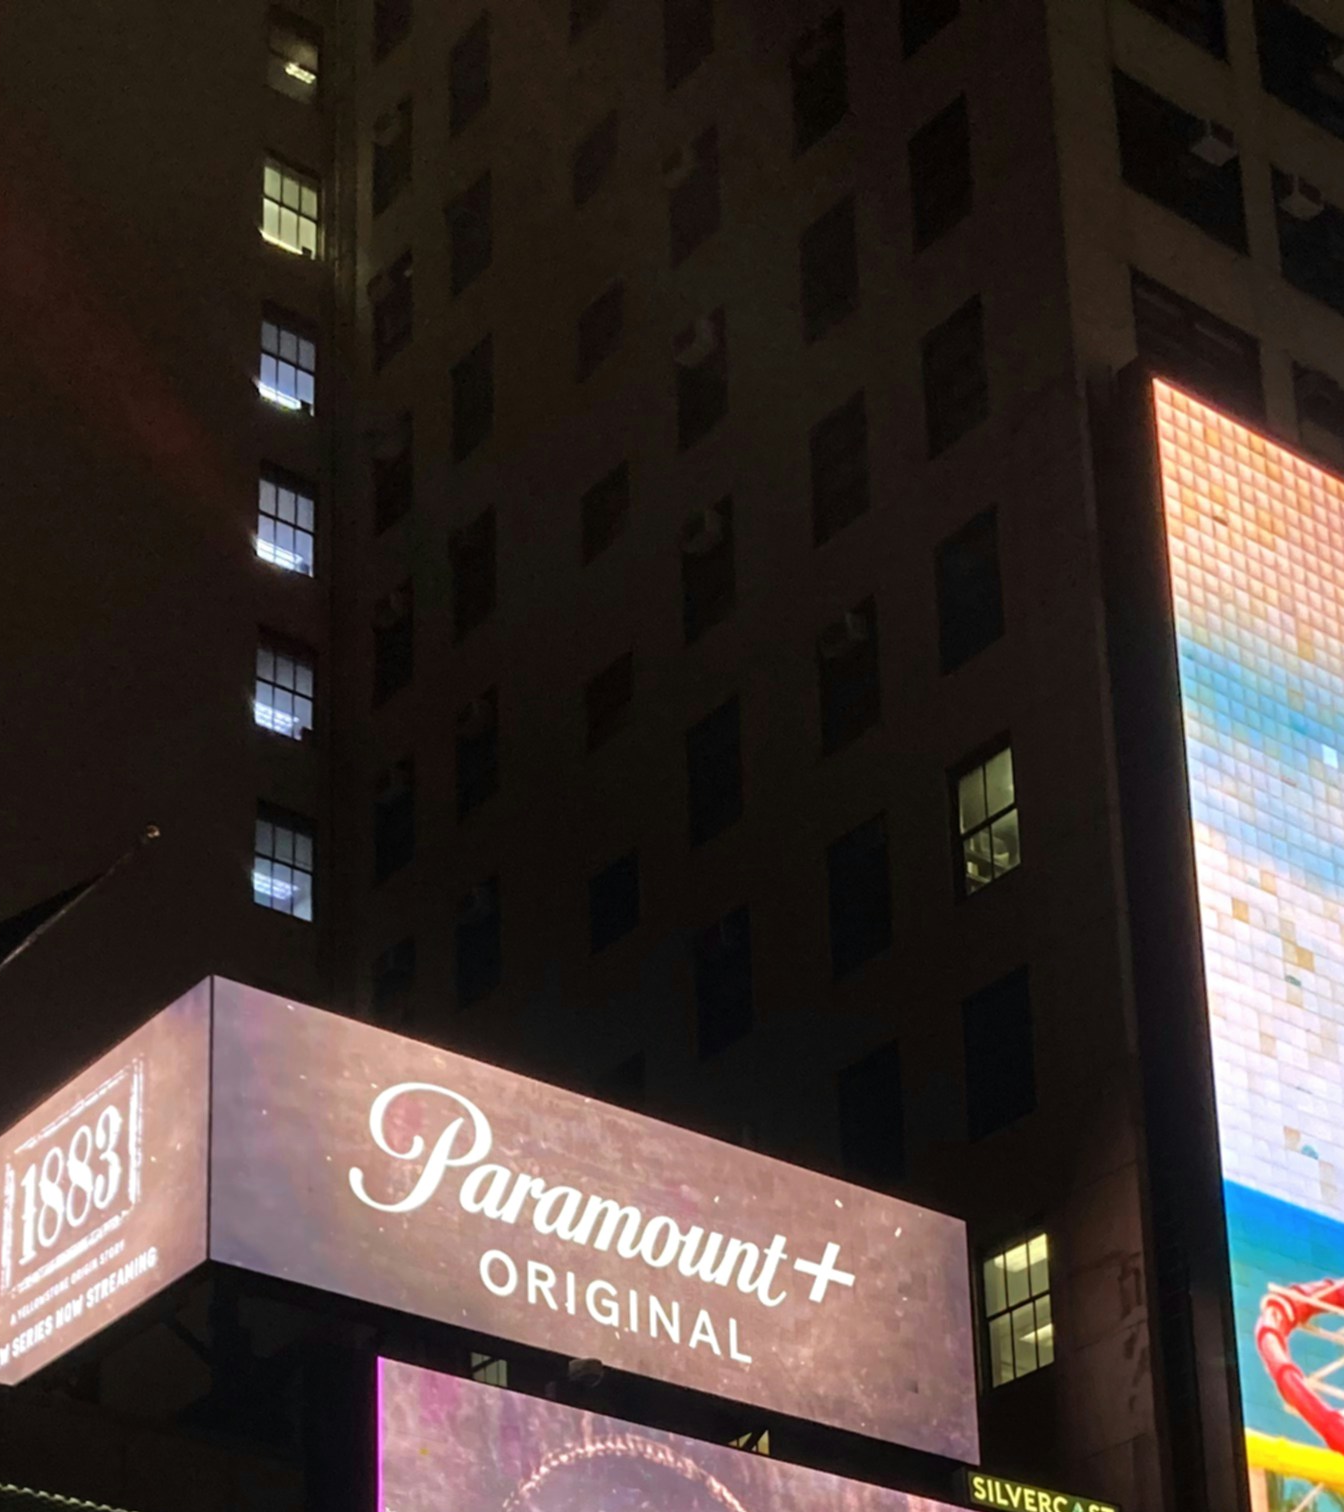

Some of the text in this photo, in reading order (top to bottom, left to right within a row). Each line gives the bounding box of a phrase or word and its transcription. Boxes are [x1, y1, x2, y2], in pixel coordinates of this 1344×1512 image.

[18, 1105, 122, 1264] 1883
[349, 1083, 855, 1306] Paramount+
[11, 1316, 53, 1356] SERIES
[56, 1297, 83, 1329] NOW
[87, 1247, 158, 1308] STREAMING
[479, 1249, 752, 1363] ORIGINAL
